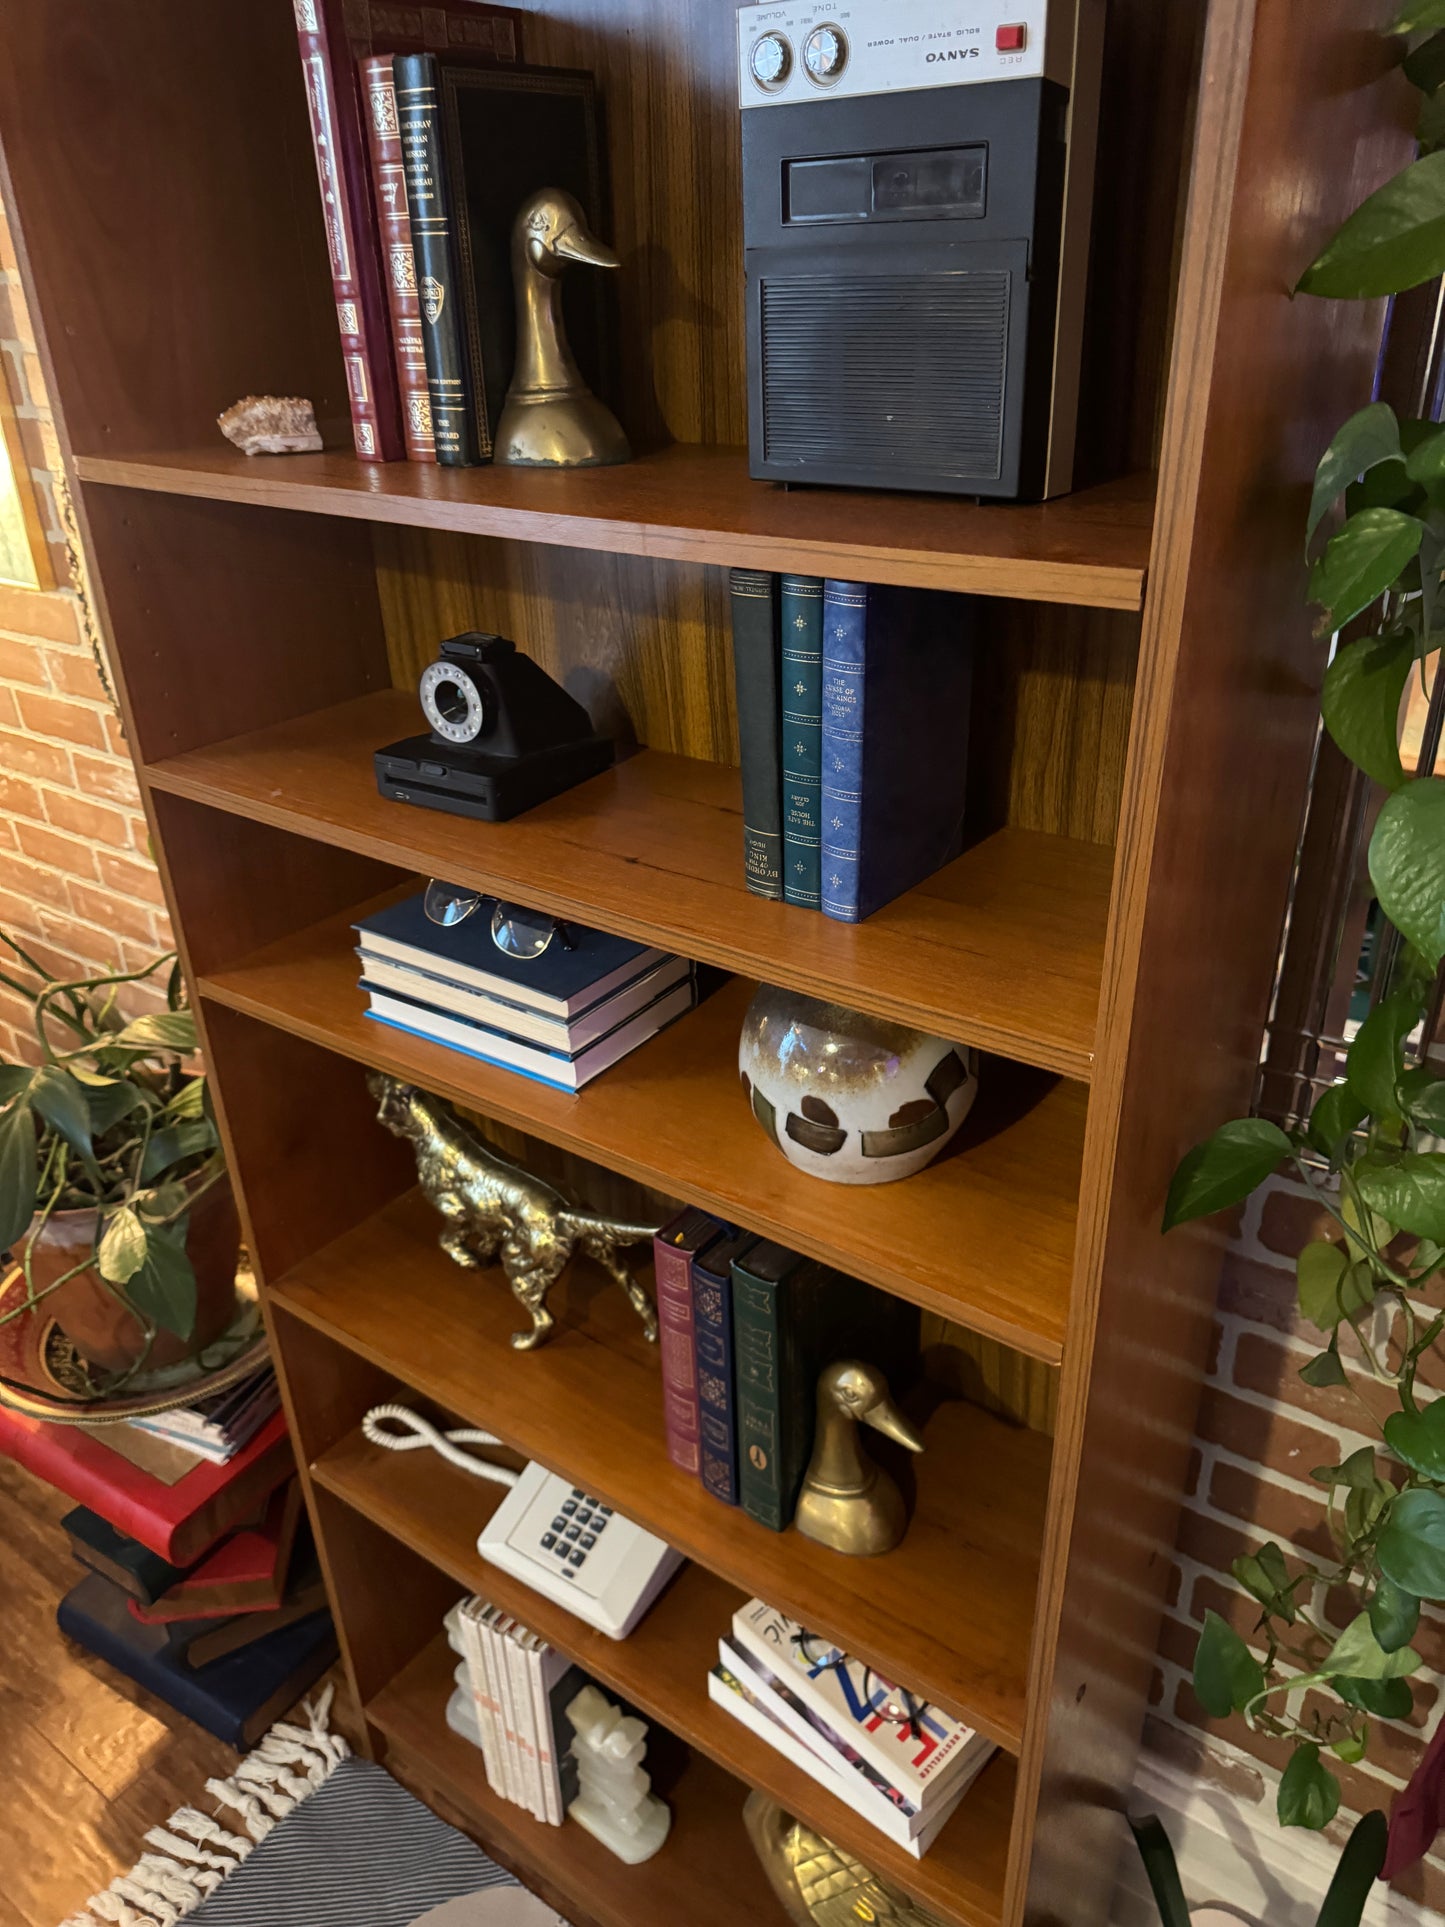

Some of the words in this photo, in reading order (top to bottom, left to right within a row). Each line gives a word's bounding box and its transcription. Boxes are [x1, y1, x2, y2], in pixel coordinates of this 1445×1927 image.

[812, 3, 837, 12] TONE
[756, 10, 787, 21] VOLUME
[928, 31, 951, 40] STATE
[956, 27, 980, 36] SOLID
[867, 39, 894, 48] POWER
[899, 35, 919, 44] DUAL
[925, 47, 980, 63] SANYO
[1000, 56, 1023, 65] REC
[836, 695, 857, 704] KINGS
[767, 869, 779, 878] BY
[919, 1733, 961, 1779] BESTSELLER
